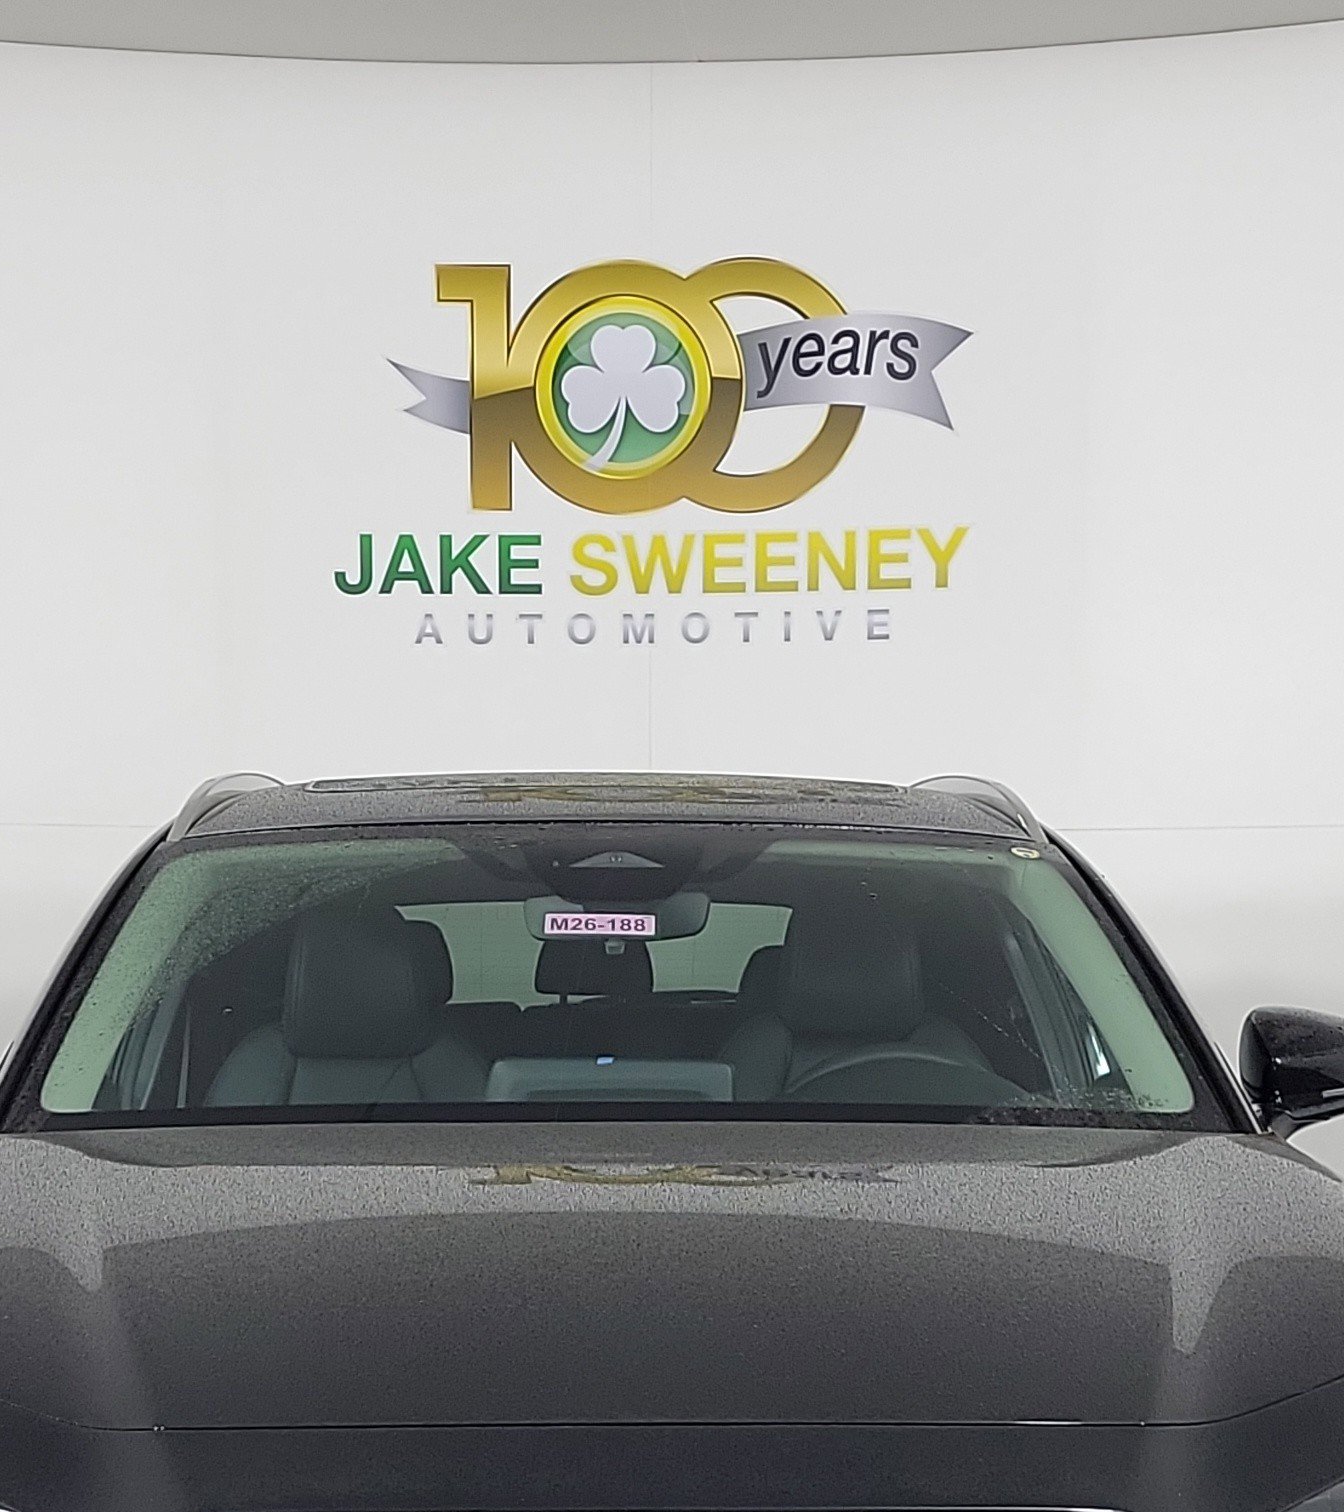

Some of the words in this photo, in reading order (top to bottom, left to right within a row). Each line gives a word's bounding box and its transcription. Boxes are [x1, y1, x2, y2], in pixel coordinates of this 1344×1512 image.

[435, 257, 867, 514] 100
[756, 328, 920, 398] years
[334, 533, 543, 595] JAKE
[569, 526, 969, 596] SWEENEY
[414, 608, 892, 645] AUTOMOTIVE
[550, 917, 646, 932] M26-188
